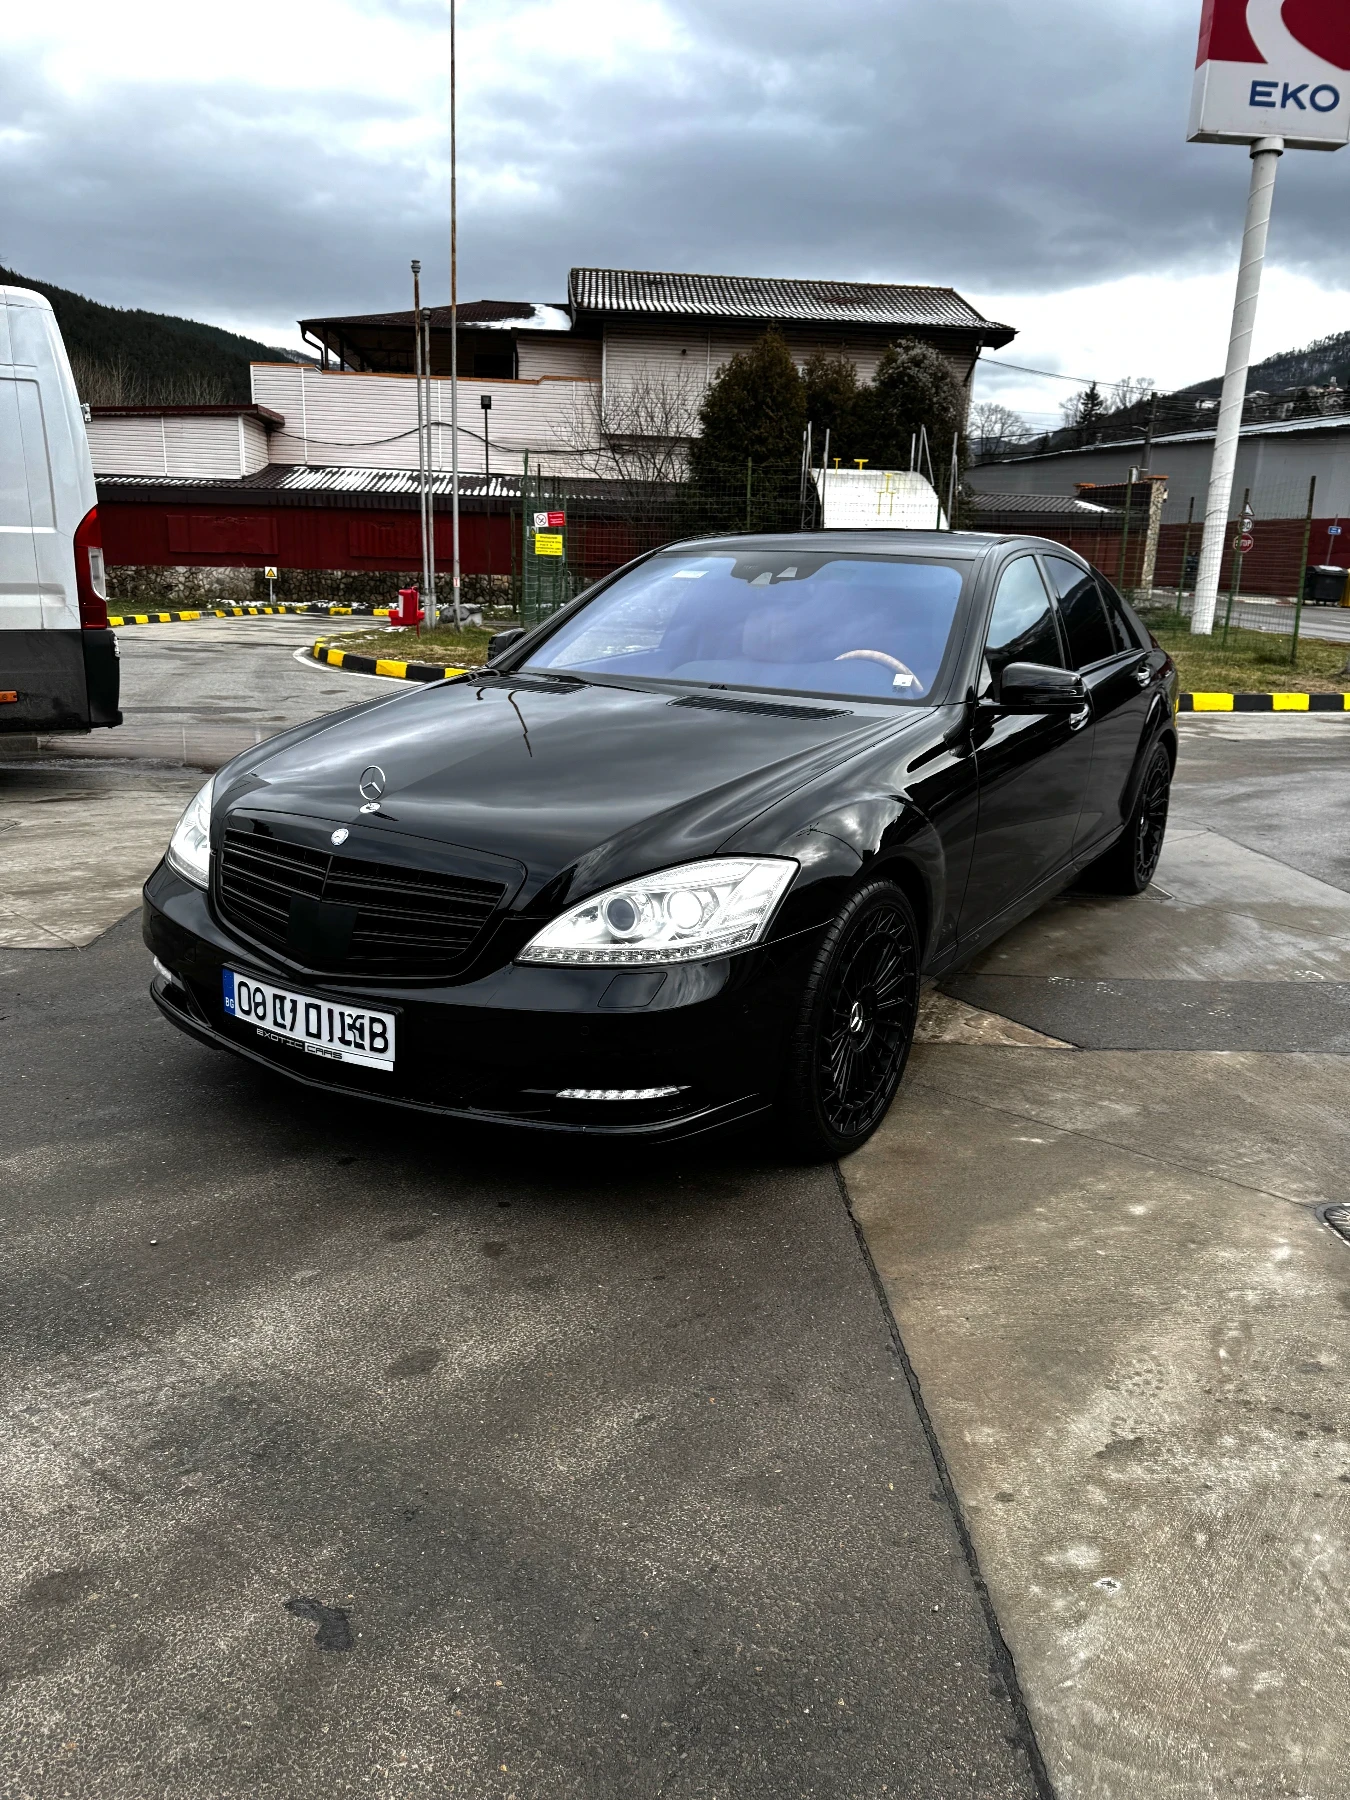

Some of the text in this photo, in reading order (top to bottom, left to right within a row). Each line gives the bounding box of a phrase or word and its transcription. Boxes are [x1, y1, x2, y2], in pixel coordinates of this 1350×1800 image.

[1249, 80, 1340, 113] EKO
[225, 996, 235, 1009] BG
[256, 1028, 343, 1060] EXOTIC CARS
